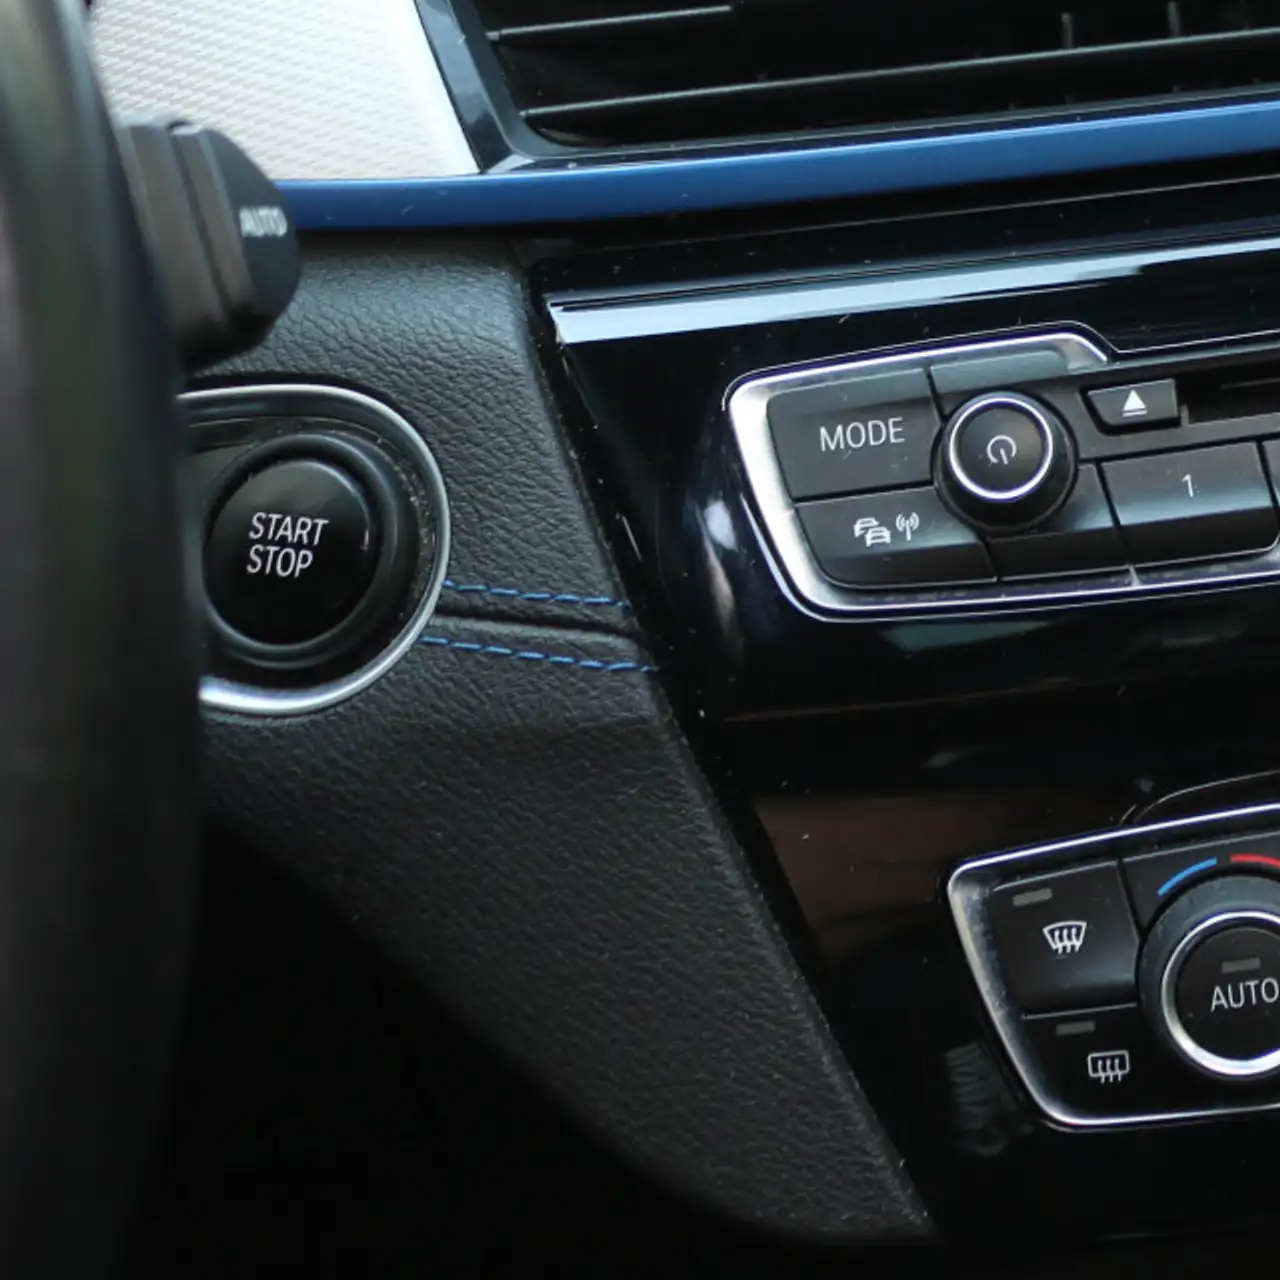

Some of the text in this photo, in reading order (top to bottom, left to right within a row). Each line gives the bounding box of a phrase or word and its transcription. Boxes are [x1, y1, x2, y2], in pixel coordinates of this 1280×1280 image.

[820, 417, 905, 452] MODE
[1181, 474, 1194, 497] 1
[249, 512, 328, 547] START
[246, 545, 314, 578] STOP
[1210, 977, 1280, 1012] AUTO
